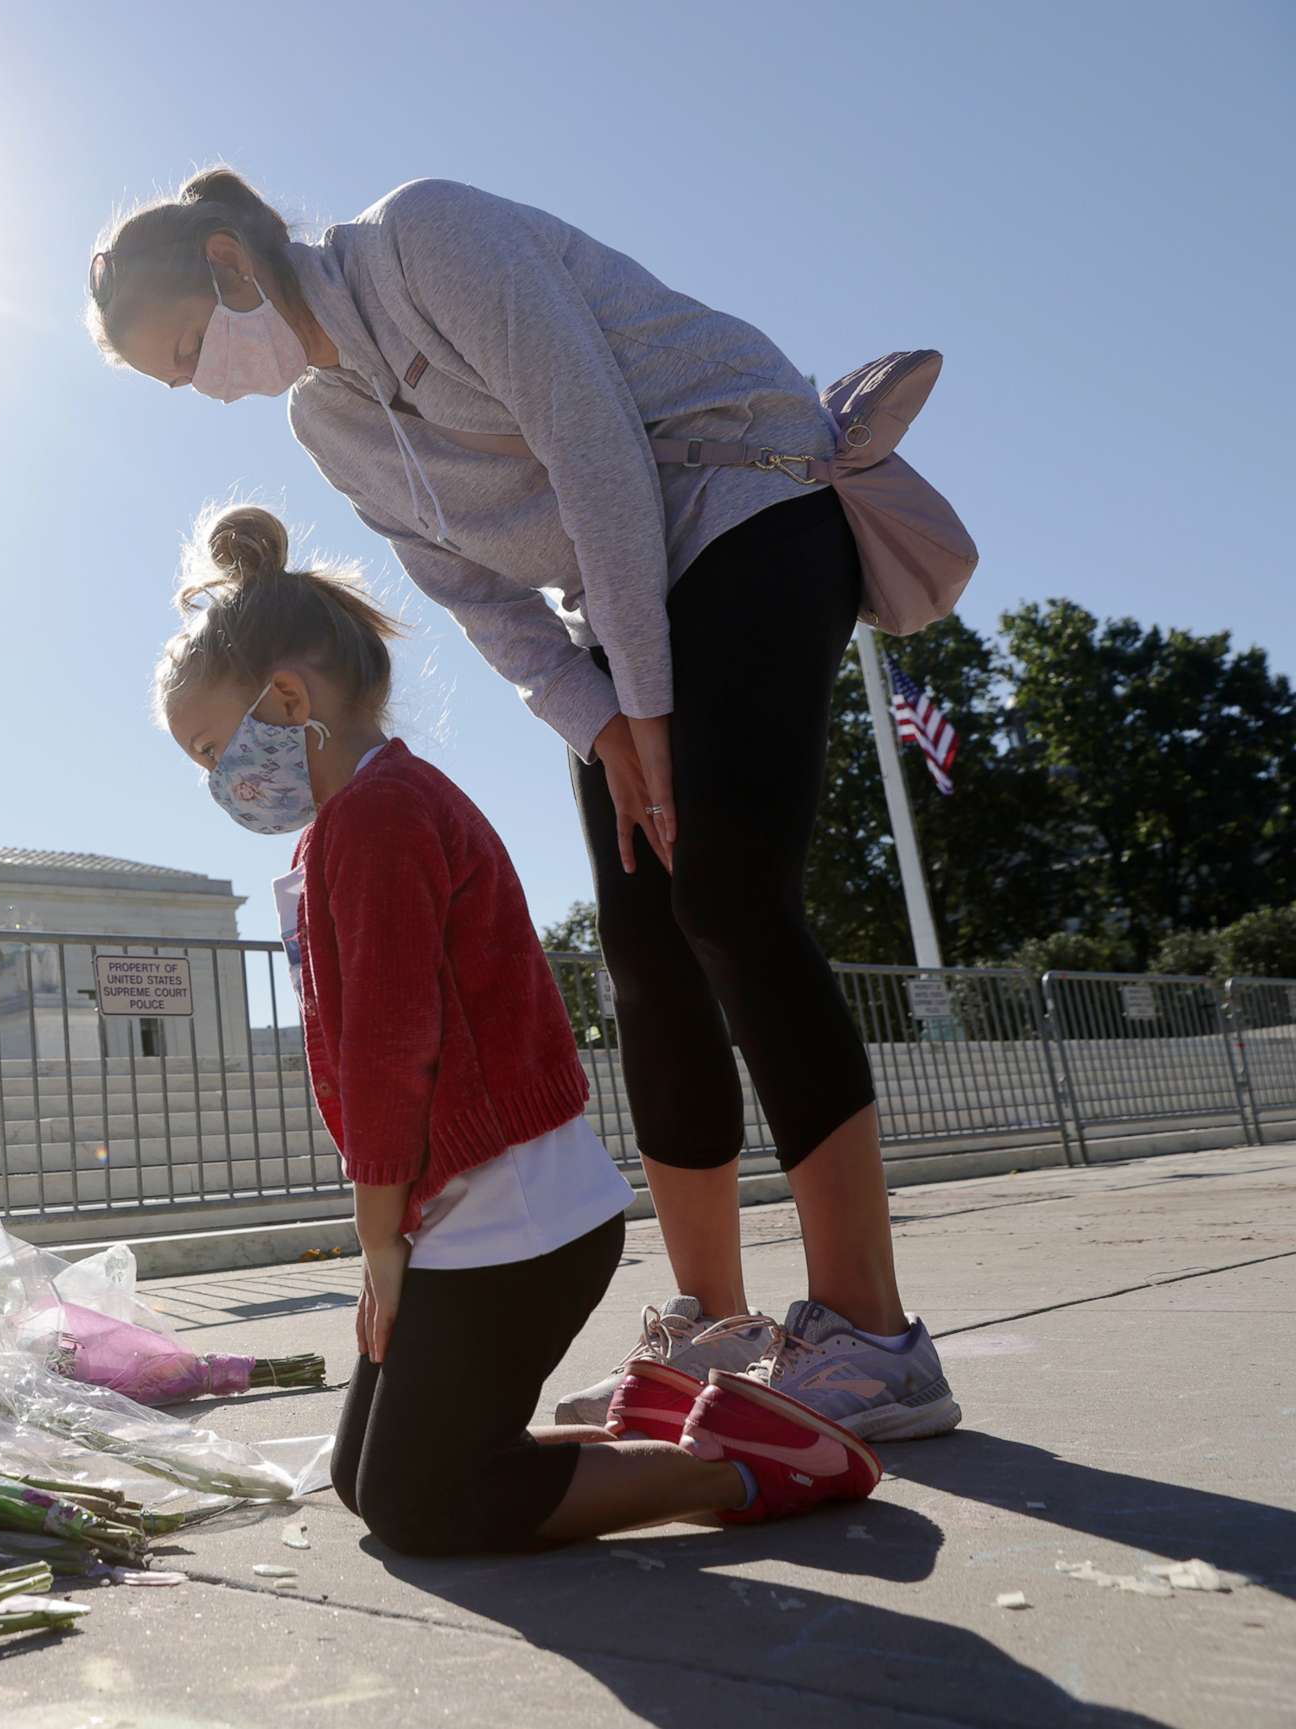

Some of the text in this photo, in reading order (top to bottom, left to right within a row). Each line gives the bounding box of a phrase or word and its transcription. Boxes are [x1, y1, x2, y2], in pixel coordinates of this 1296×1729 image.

[108, 962, 178, 974] PROPERTY OF
[107, 974, 183, 986] UNITED STATES
[103, 986, 188, 998] SUPREME COURT
[129, 999, 166, 1010] POLICE
